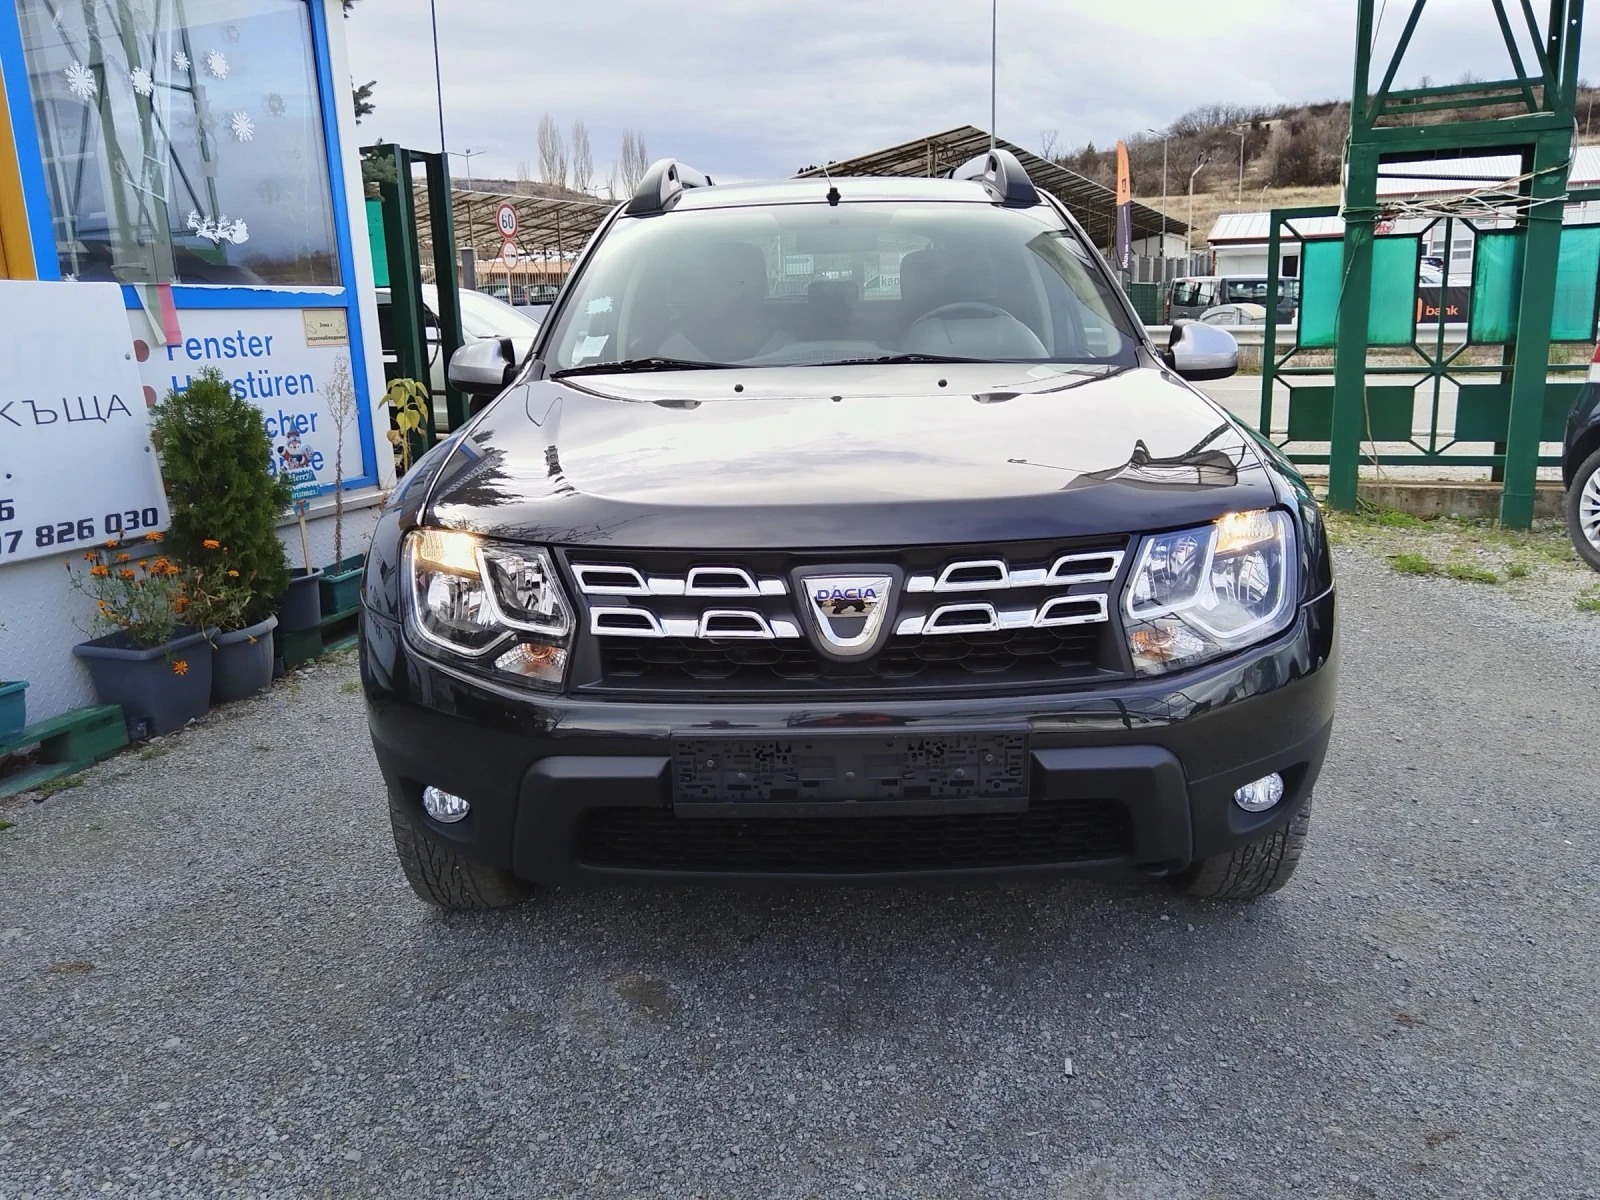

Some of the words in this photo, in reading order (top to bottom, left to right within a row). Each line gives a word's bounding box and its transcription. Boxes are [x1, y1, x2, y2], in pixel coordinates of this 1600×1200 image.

[501, 213, 514, 229] 60
[166, 330, 273, 361] Fenster
[171, 369, 314, 401] Hstüren
[0, 529, 24, 555] 7
[35, 517, 95, 548] 826
[104, 507, 159, 535] 030
[817, 588, 877, 599] DACIA
